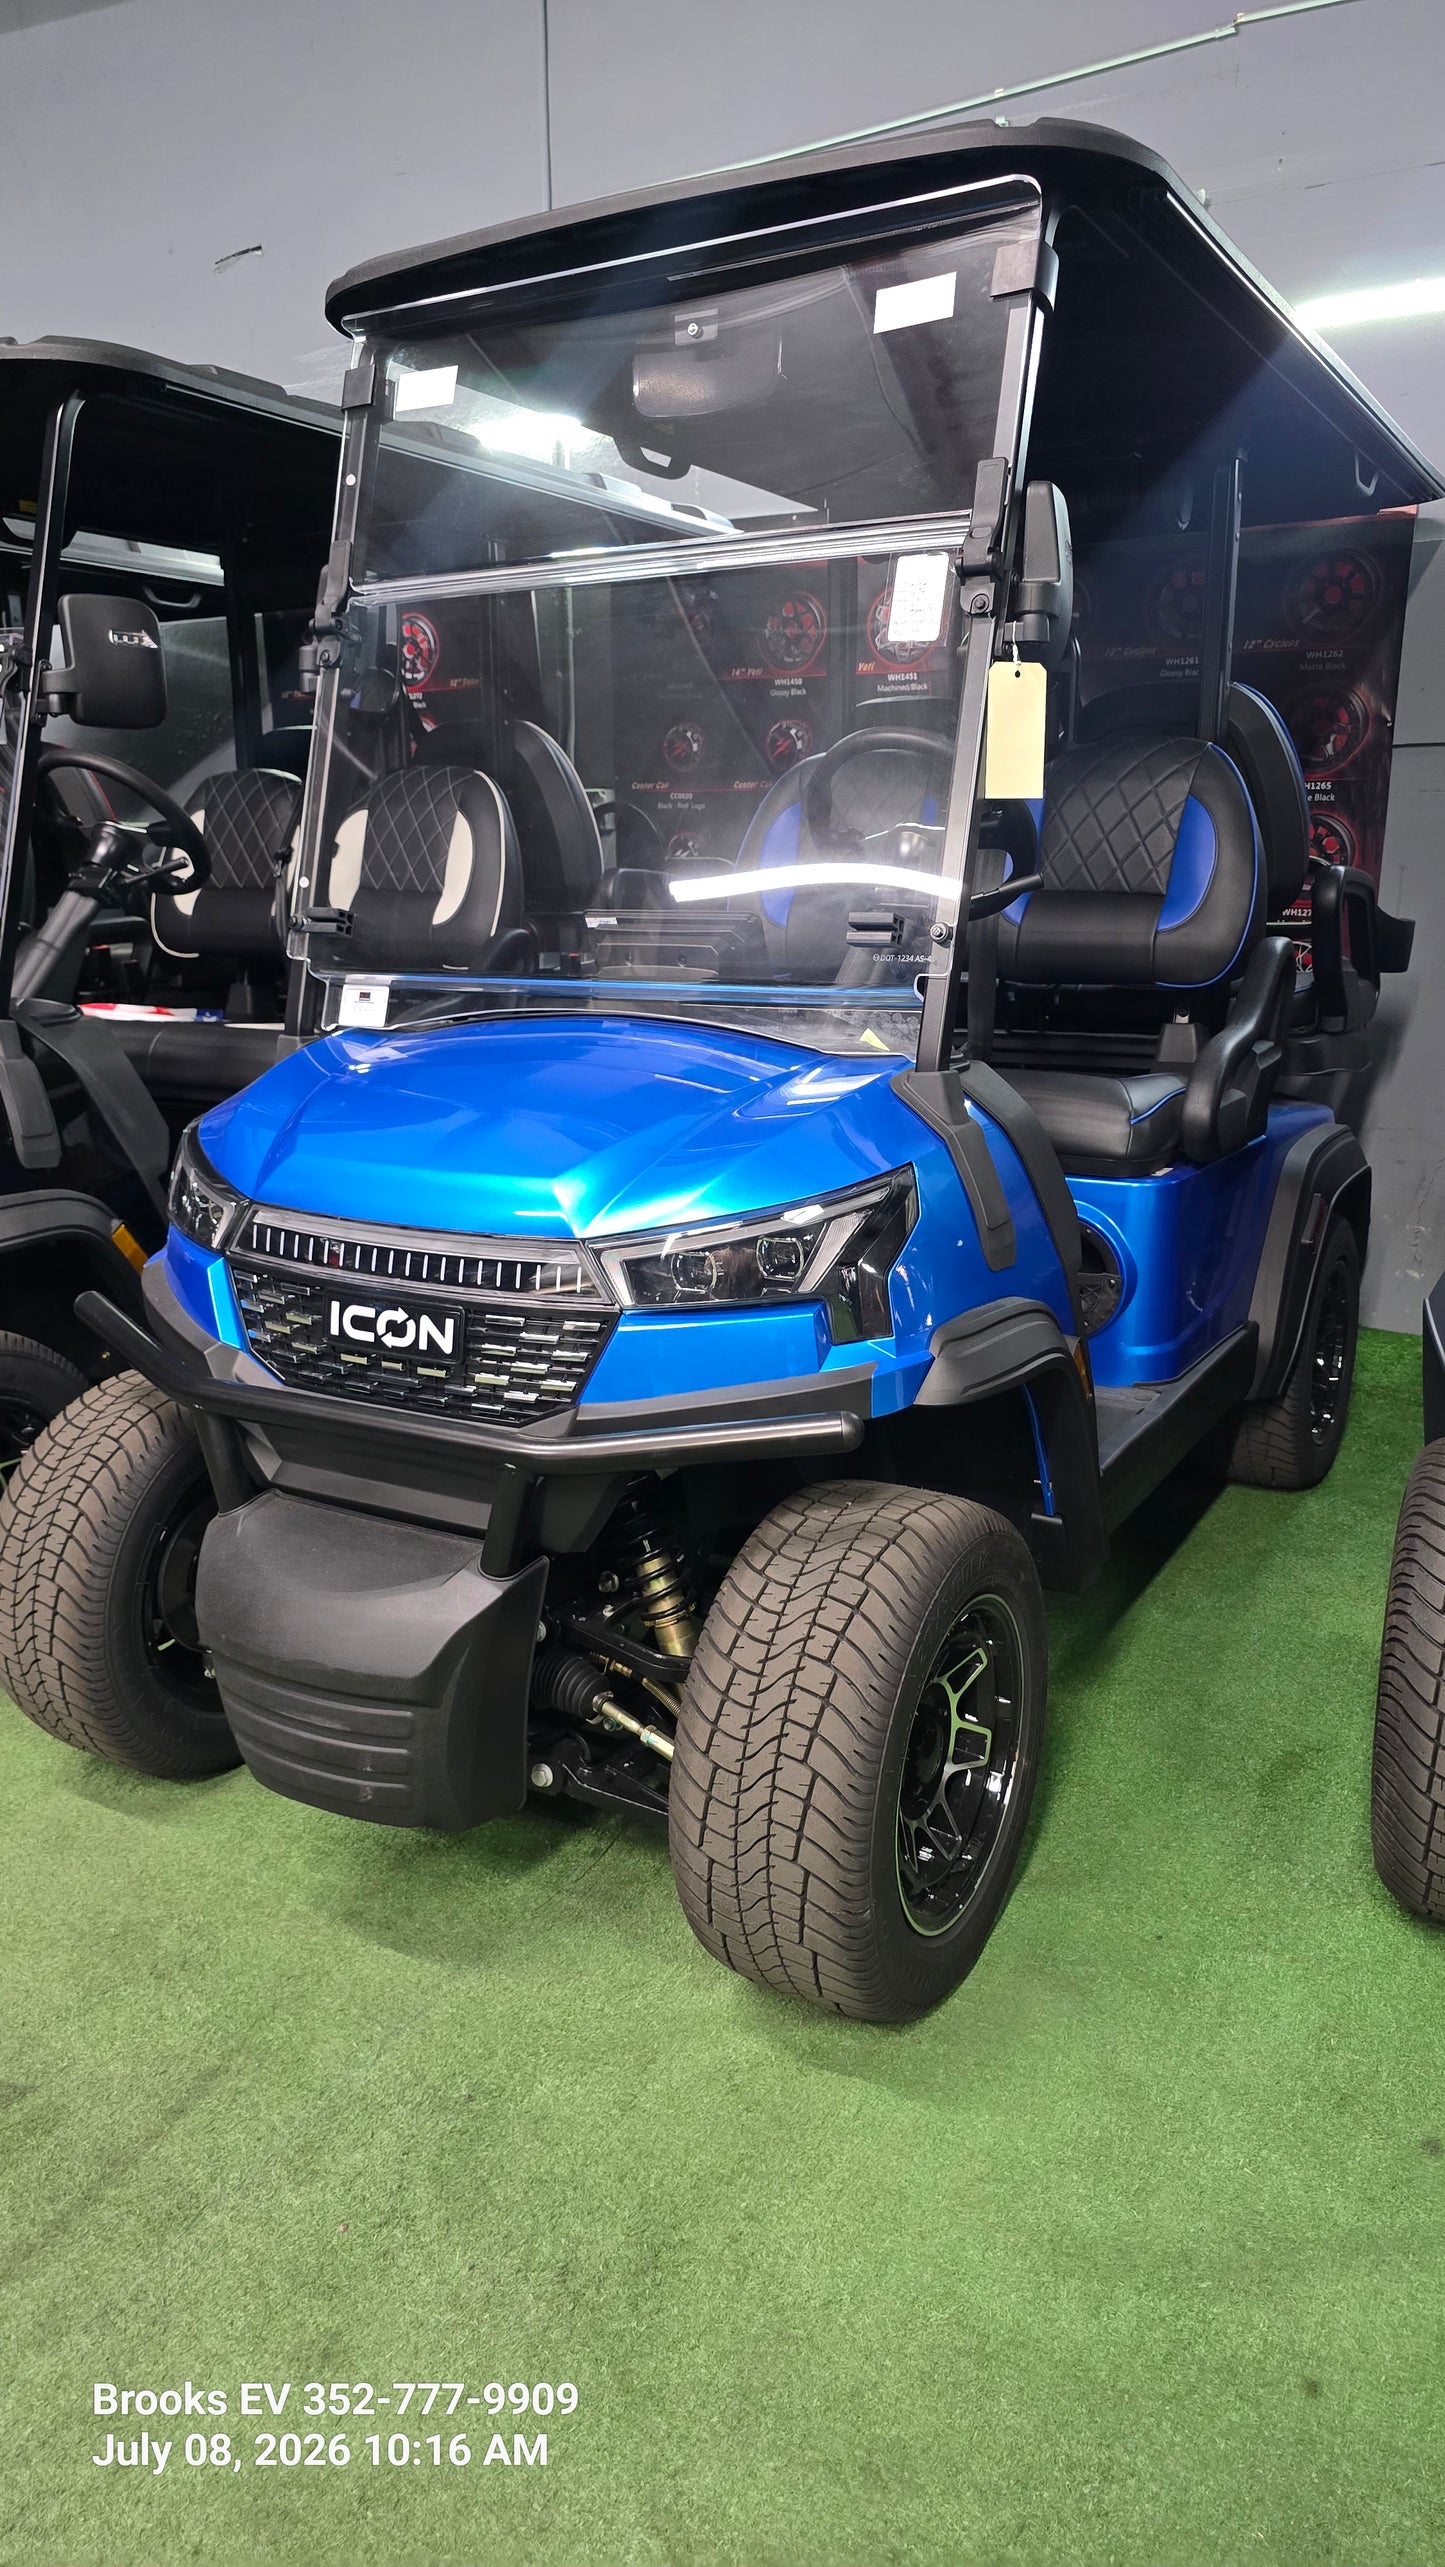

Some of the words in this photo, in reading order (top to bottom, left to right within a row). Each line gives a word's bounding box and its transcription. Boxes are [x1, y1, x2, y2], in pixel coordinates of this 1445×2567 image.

[1305, 649, 1345, 659] WH1262
[1164, 656, 1200, 666] WH1261
[1325, 662, 1347, 671] Black
[1159, 668, 1184, 679] Glossy
[1184, 668, 1200, 677] Blac
[1304, 782, 1332, 790] H1265
[1314, 793, 1336, 802] Black
[1282, 908, 1312, 917] WH127
[330, 1299, 456, 1356] ICON
